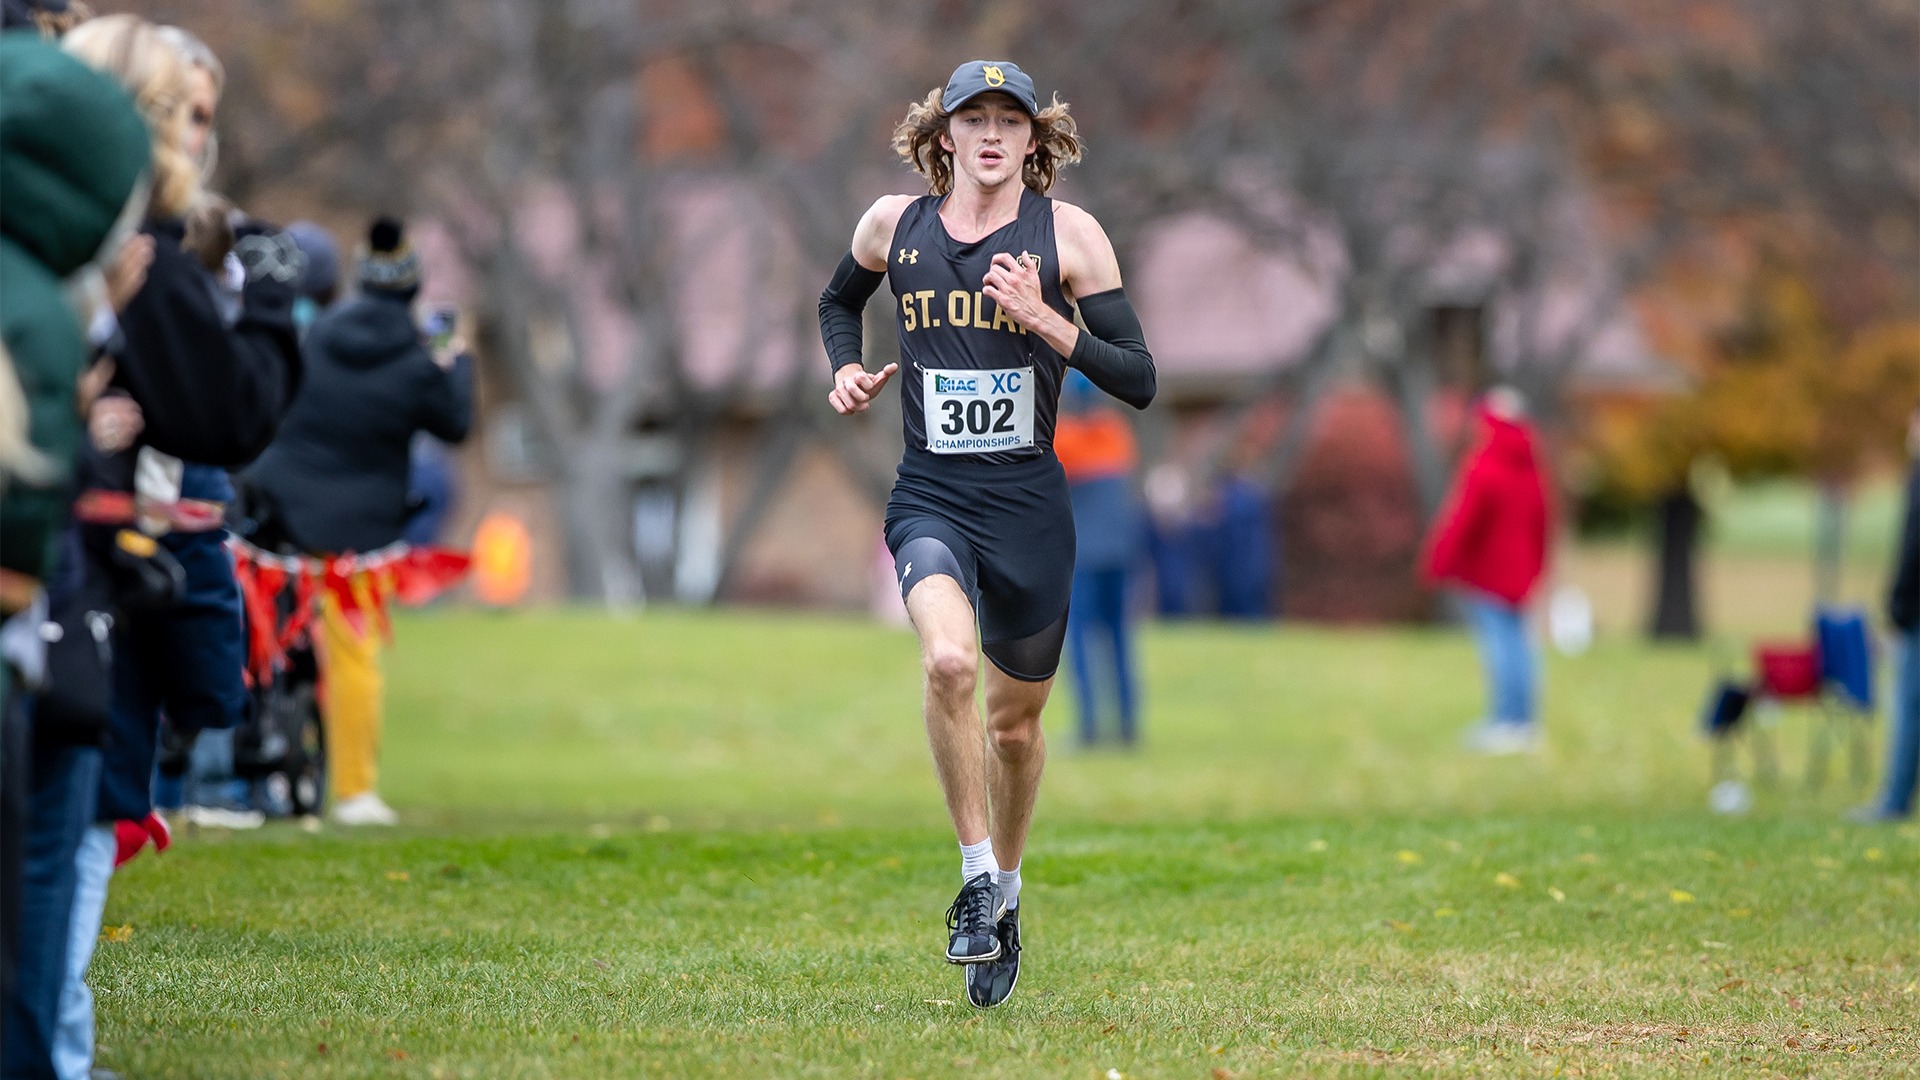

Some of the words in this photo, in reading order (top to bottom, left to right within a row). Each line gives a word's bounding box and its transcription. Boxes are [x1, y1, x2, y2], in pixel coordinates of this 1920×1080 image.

[902, 290, 940, 332] ST.
[948, 290, 1026, 335] OLA
[940, 379, 977, 392] MIAC
[991, 372, 1021, 394] XC
[941, 398, 1015, 435] 302
[935, 436, 1021, 449] CHAMPIONSHIPS
